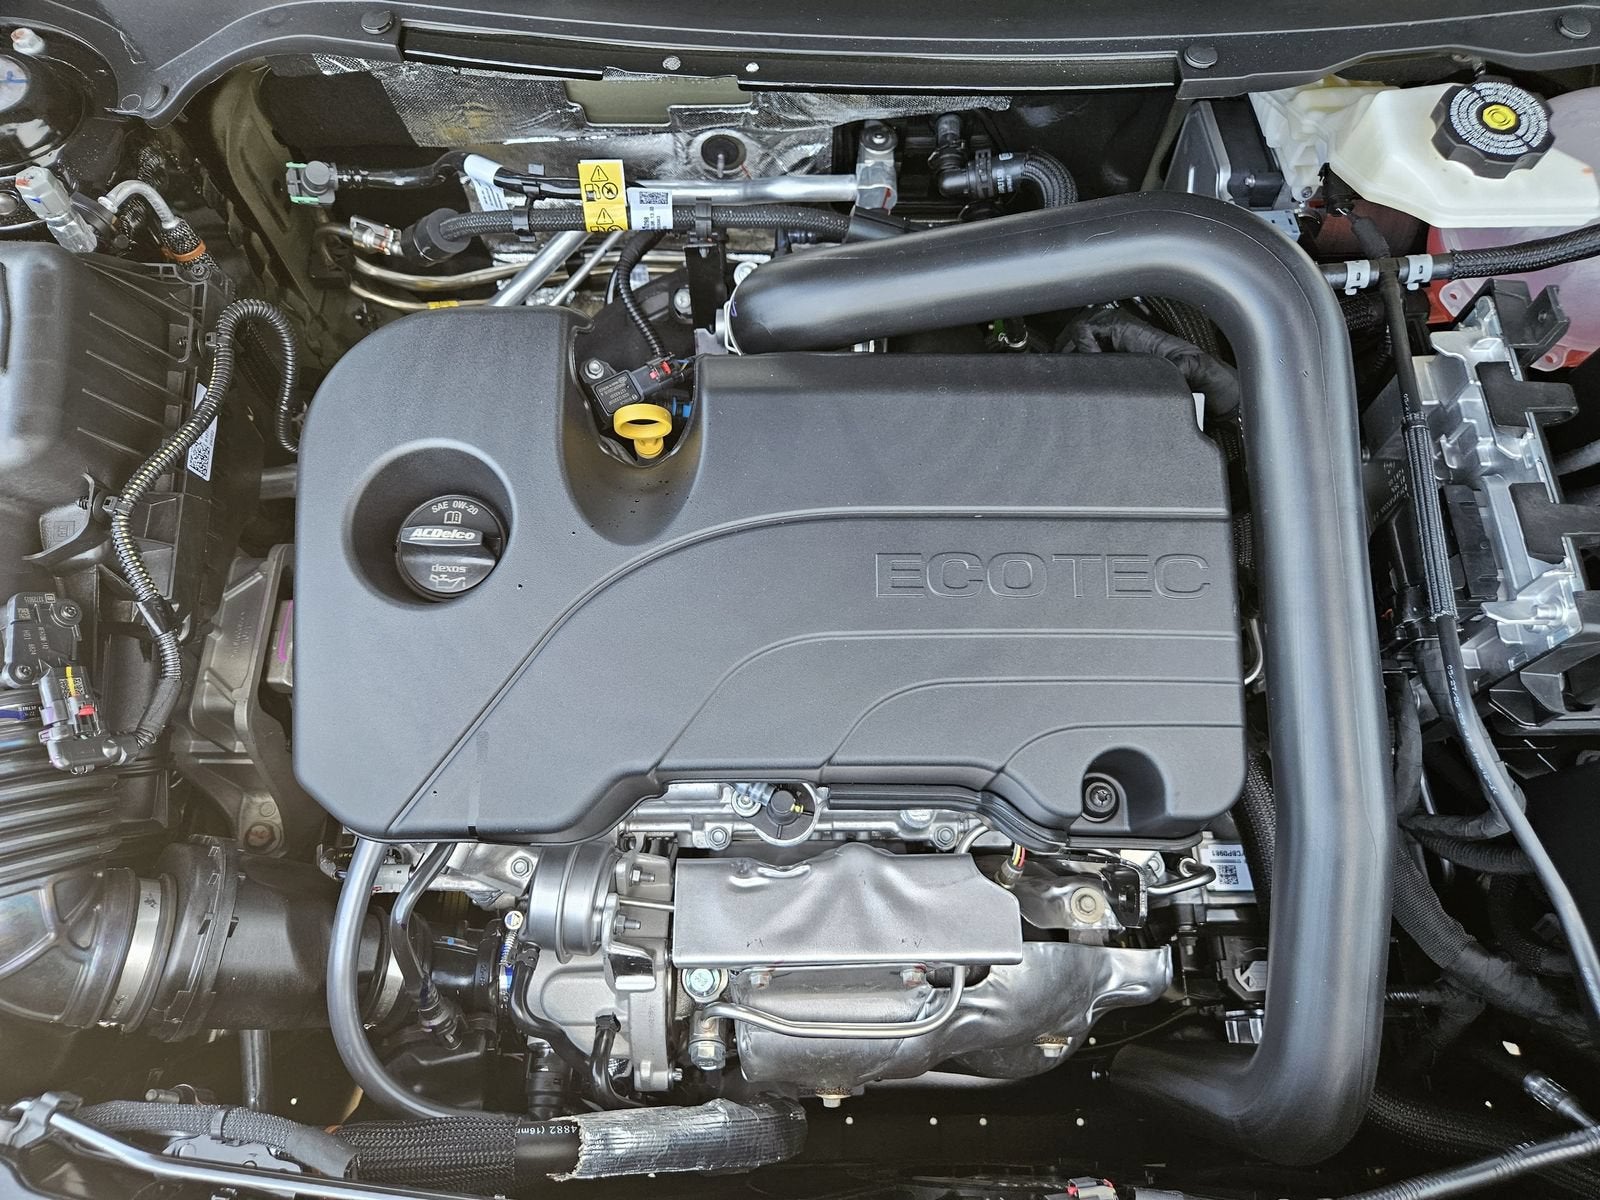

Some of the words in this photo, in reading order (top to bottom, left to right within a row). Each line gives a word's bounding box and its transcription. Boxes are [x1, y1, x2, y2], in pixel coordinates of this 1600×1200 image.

[431, 501, 449, 513] SAE
[452, 500, 479, 515] 0W-20
[410, 528, 476, 540] ACDelco
[431, 563, 468, 573] dexos
[875, 551, 1211, 600] ECOTEC
[549, 1125, 578, 1135] 4882
